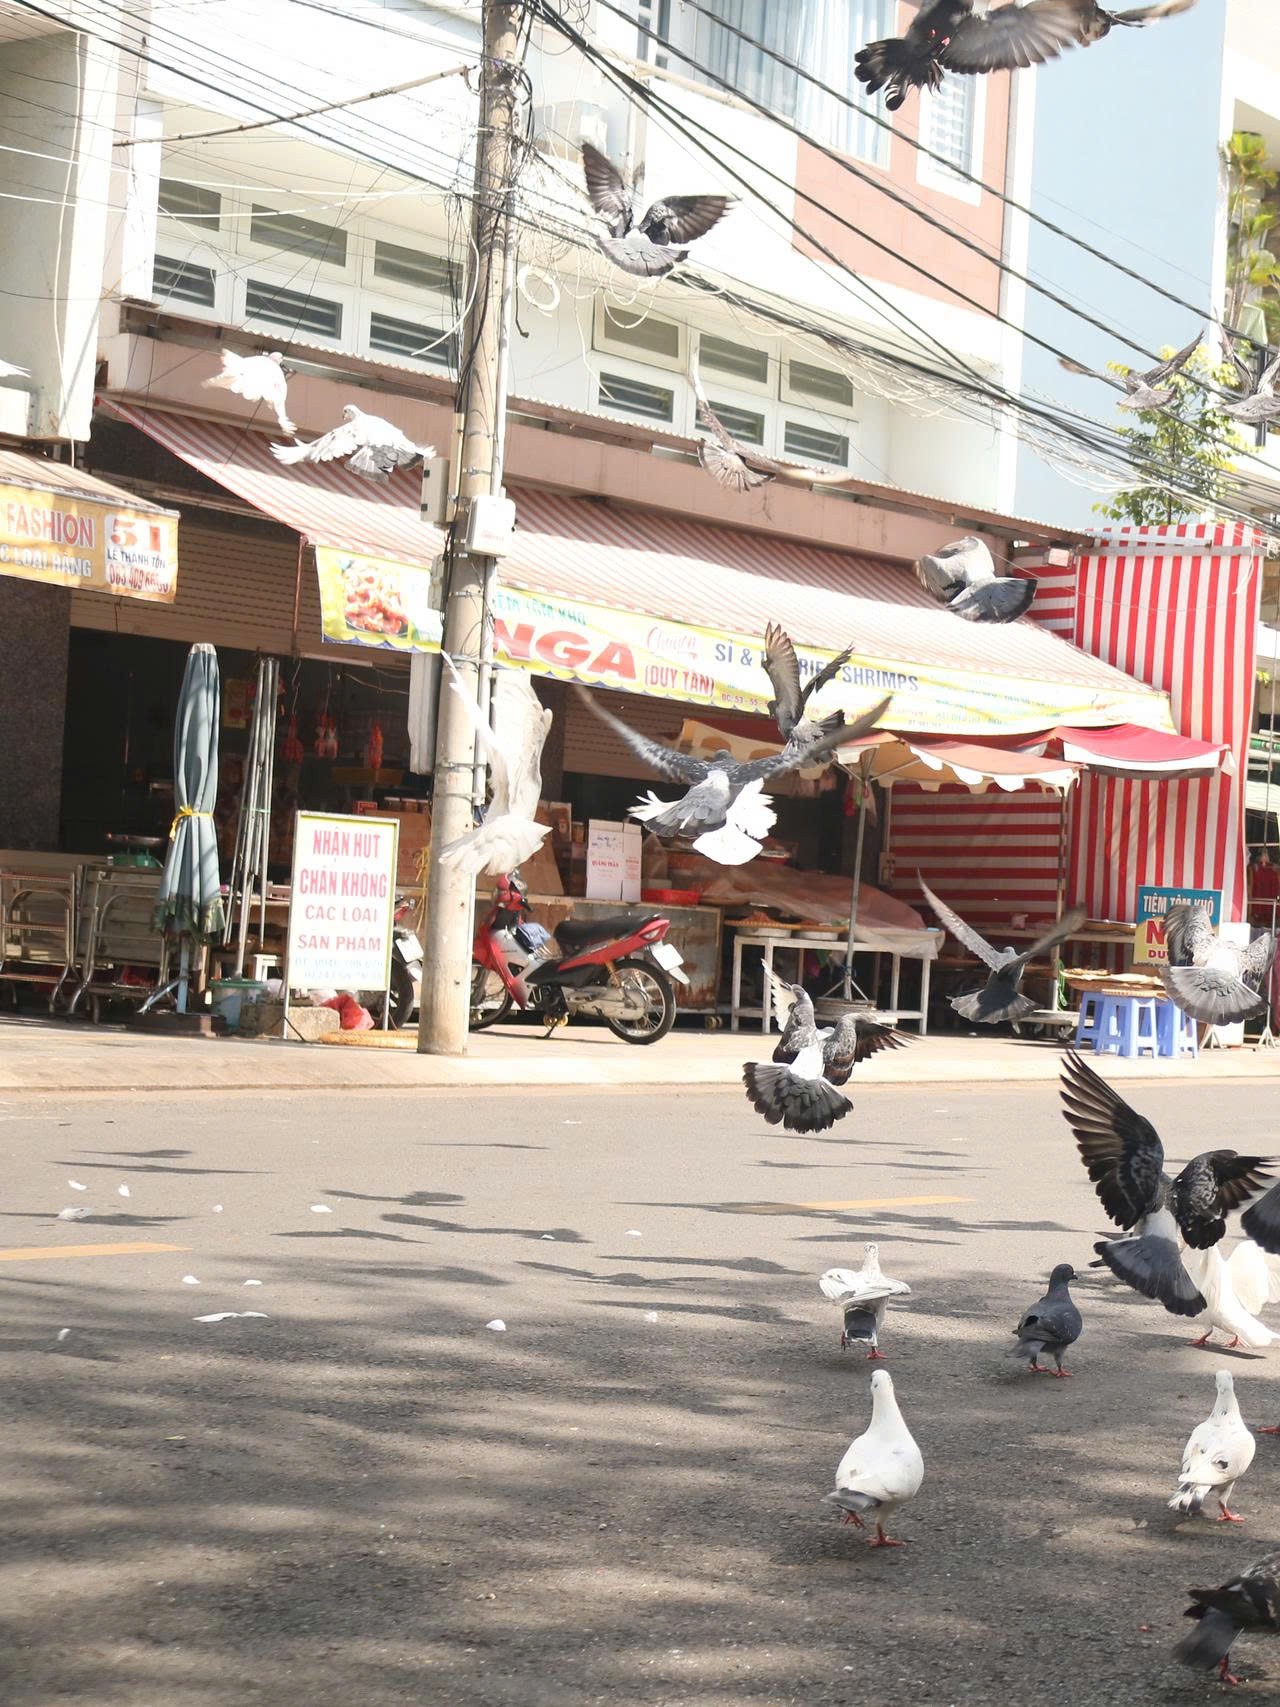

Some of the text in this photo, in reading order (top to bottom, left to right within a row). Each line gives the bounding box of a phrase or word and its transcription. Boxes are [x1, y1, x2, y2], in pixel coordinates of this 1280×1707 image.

[7, 503, 95, 548] FASHION
[494, 618, 637, 681] NGA
[741, 649, 752, 666] &
[842, 665, 919, 691] SHRIMPS
[1144, 892, 1167, 916] TIỆM
